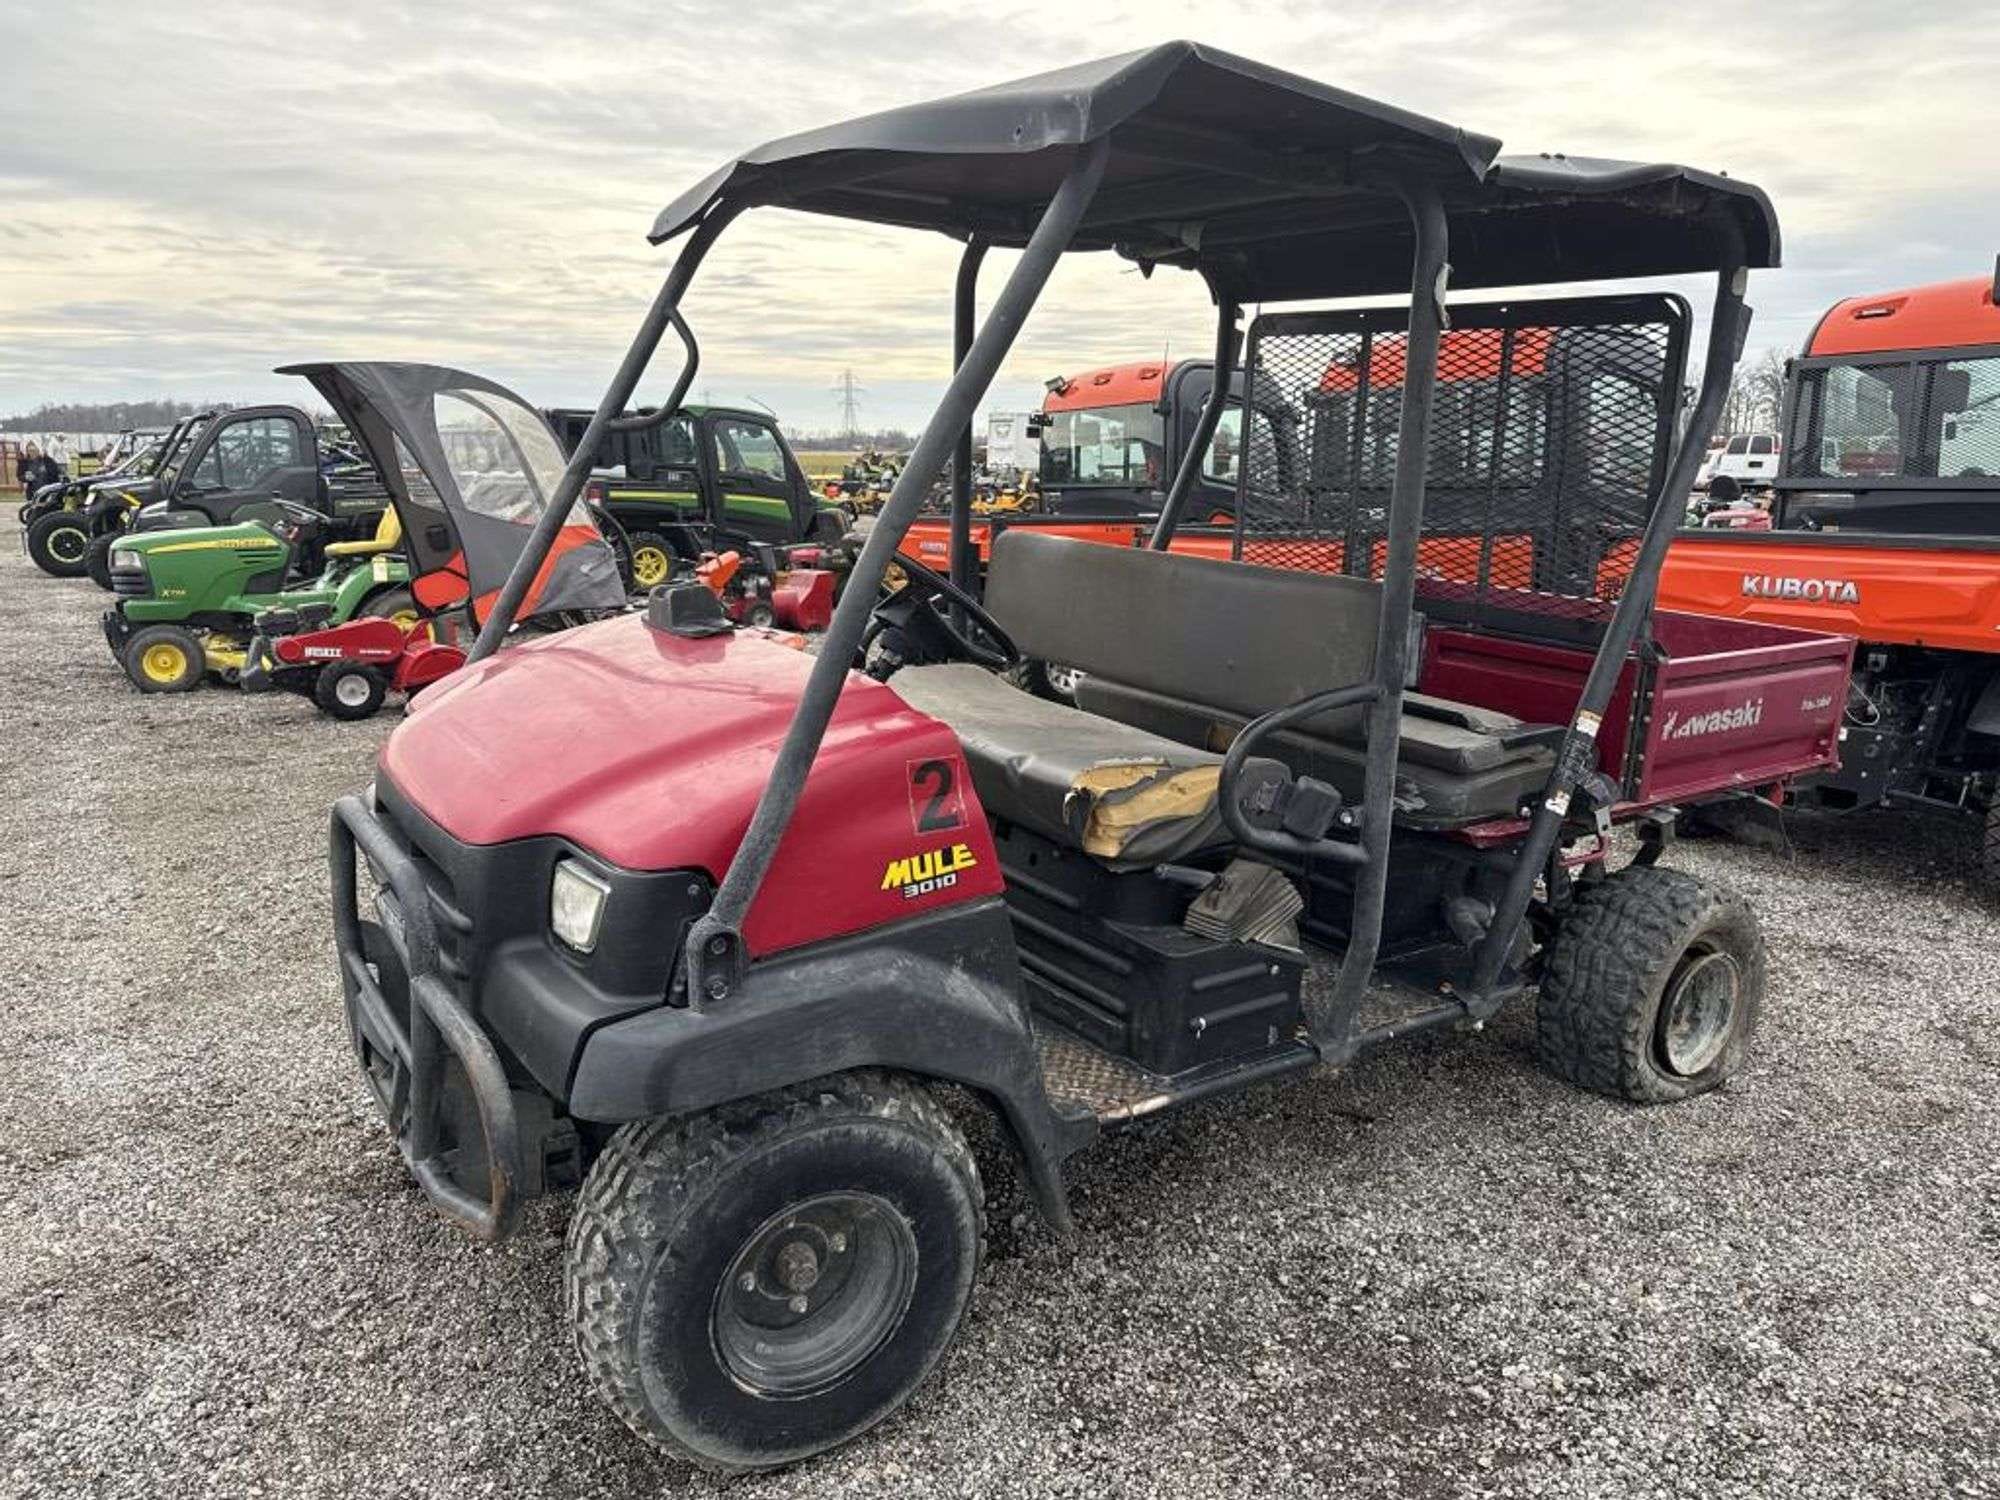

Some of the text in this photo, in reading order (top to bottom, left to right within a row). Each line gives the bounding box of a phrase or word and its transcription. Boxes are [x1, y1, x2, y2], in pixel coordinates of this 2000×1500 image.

[1742, 574, 1859, 603] KUBOTA
[913, 759, 961, 833] 2
[880, 843, 978, 891] MULE
[904, 873, 957, 898] 3010
